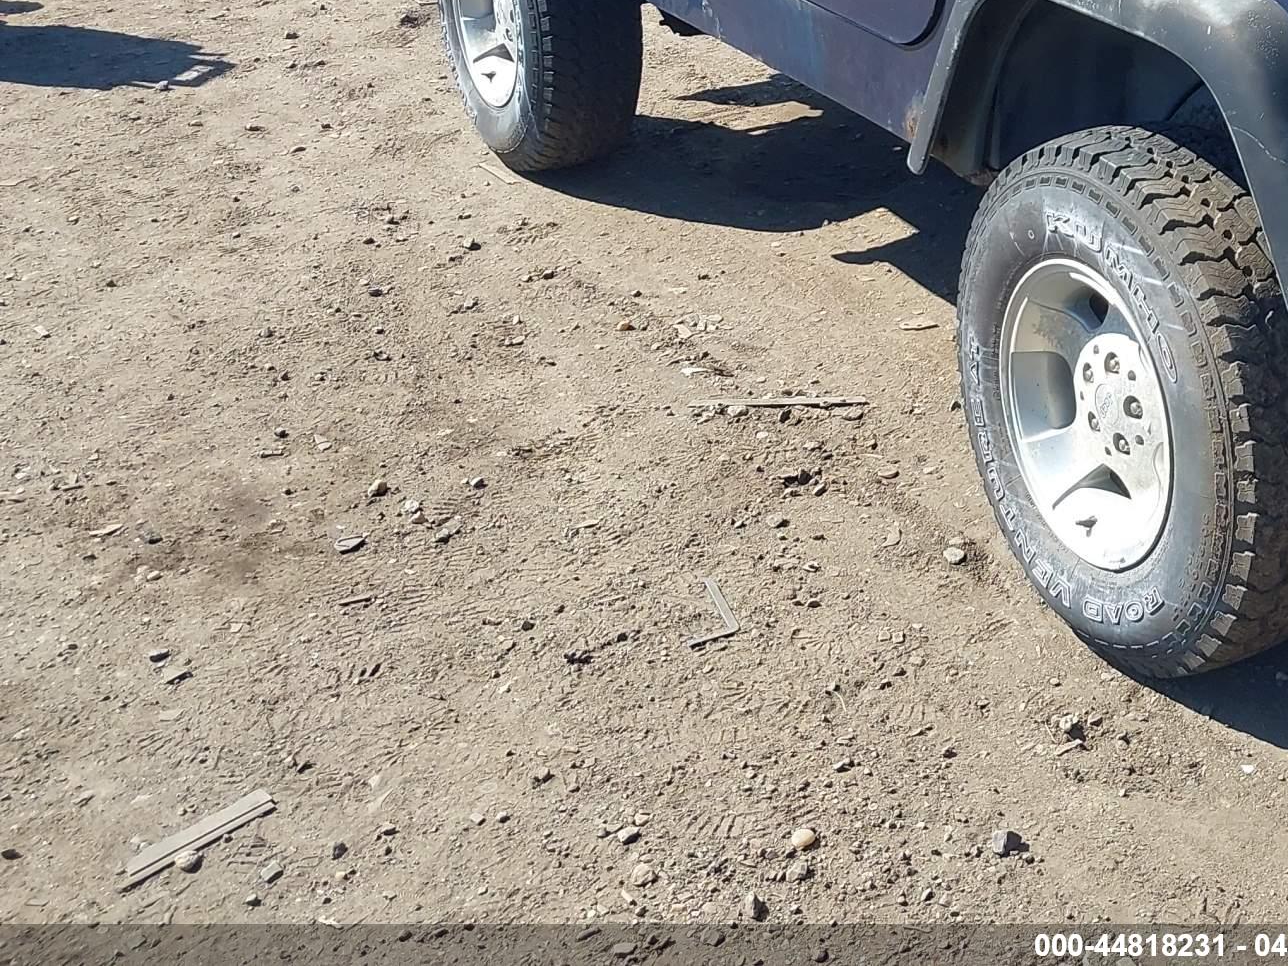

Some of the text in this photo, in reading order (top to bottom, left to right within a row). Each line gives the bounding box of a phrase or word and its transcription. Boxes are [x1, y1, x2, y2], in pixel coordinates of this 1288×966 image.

[1045, 211, 1178, 383] KUMHO
[969, 397, 1073, 610] VENTURE
[1081, 585, 1166, 626] ROAD
